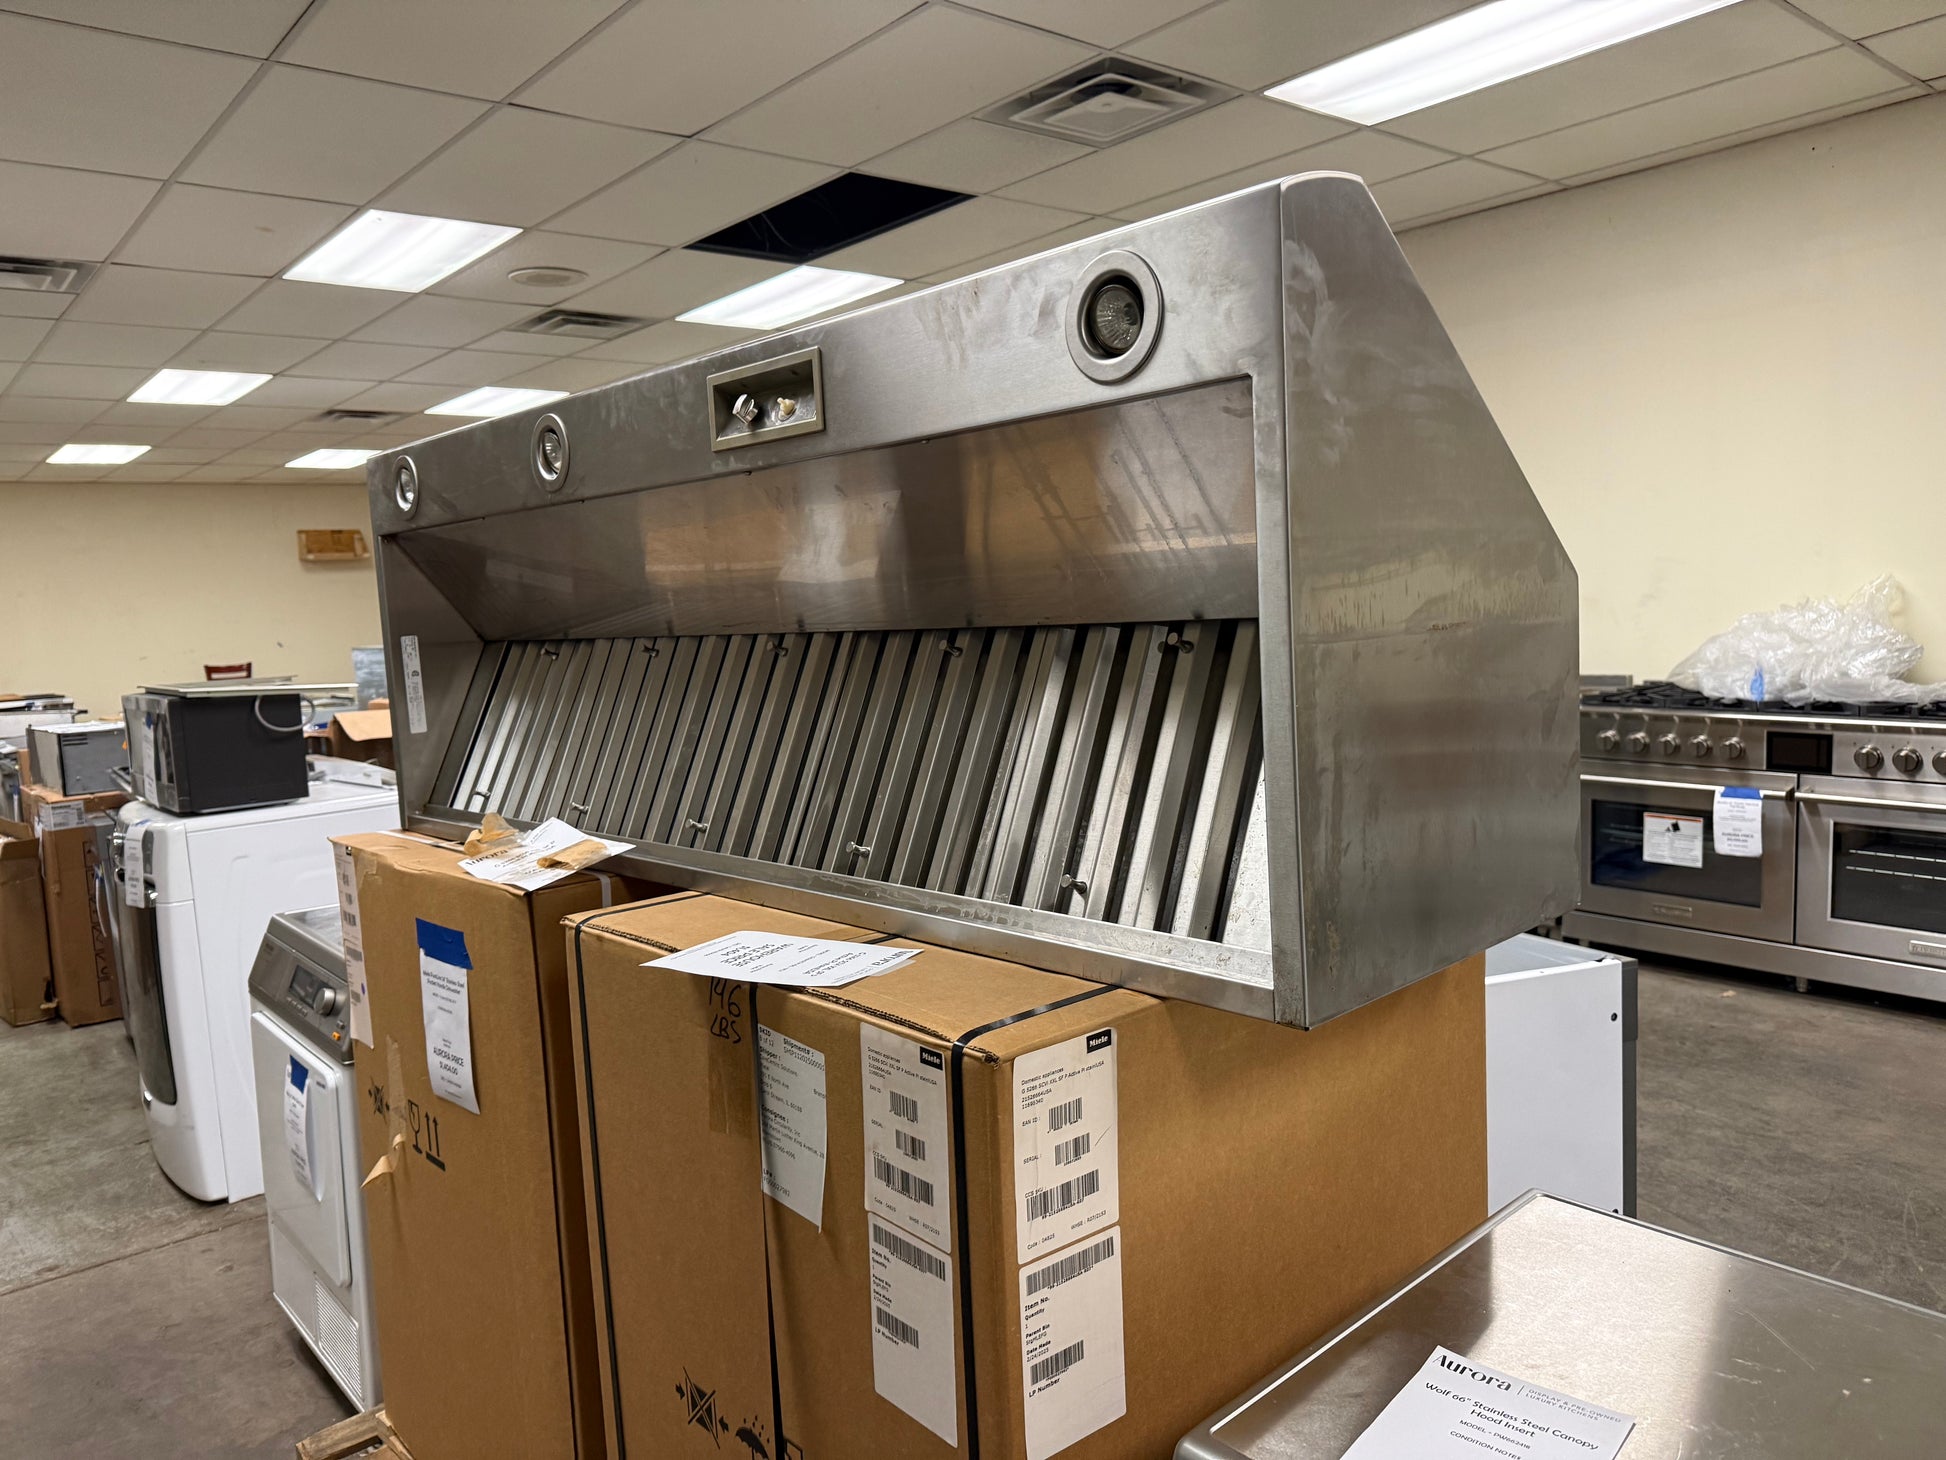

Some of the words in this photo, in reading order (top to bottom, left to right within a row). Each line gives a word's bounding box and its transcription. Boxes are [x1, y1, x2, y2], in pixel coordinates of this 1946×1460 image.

[709, 977, 742, 1018] 146
[710, 1014, 742, 1044] LBS
[1089, 1035, 1109, 1048] Miele
[922, 1052, 941, 1065] Miele
[1024, 1301, 1039, 1312] Item
[1040, 1296, 1050, 1304] No.
[1024, 1307, 1045, 1321] Quantity
[1025, 1327, 1041, 1339] Parent
[1432, 1354, 1512, 1392] Aurora
[1028, 1389, 1037, 1398] LP
[1037, 1378, 1061, 1393] Number
[1525, 1393, 1557, 1407] LUXURY
[1558, 1404, 1600, 1421] KITCHENS
[1528, 1388, 1561, 1403] DISPLAY
[1571, 1403, 1622, 1423] PRE-OWNED
[1425, 1382, 1452, 1397] Wolf
[1452, 1394, 1472, 1403] 66"
[1472, 1401, 1518, 1422] Stainless
[1520, 1418, 1550, 1433] Steel
[1552, 1429, 1599, 1450] Canopy
[1470, 1409, 1503, 1425] Hood
[1504, 1421, 1536, 1438] Insert
[1459, 1419, 1486, 1434] MODEL
[1450, 1430, 1494, 1450] CONDITION
